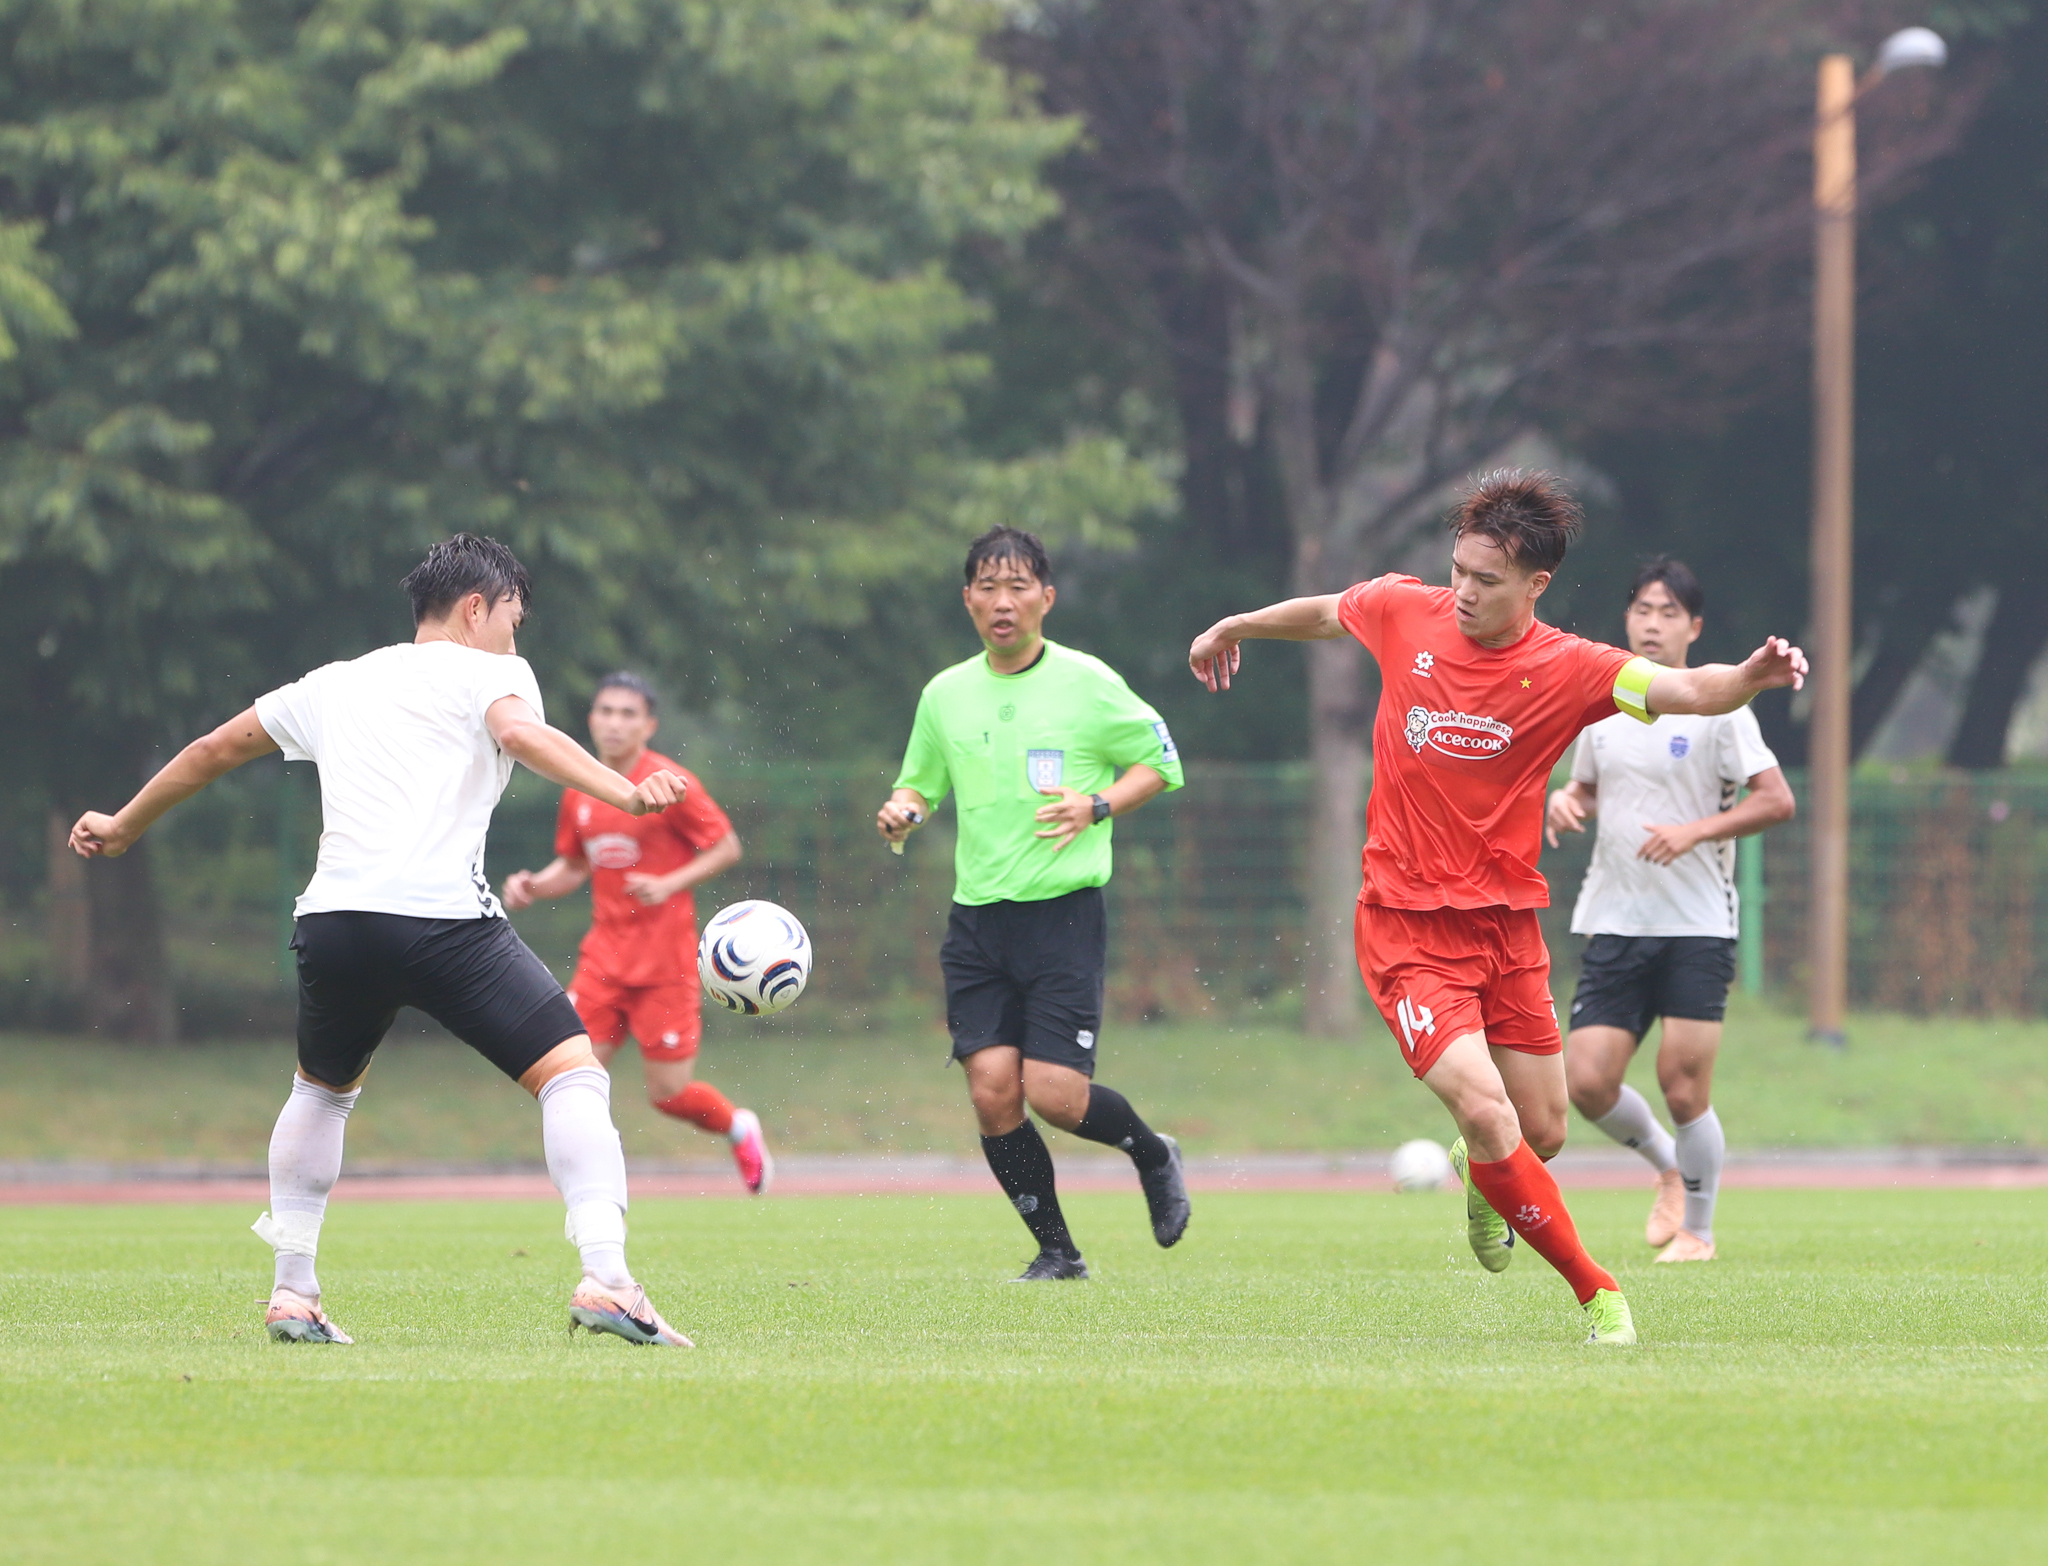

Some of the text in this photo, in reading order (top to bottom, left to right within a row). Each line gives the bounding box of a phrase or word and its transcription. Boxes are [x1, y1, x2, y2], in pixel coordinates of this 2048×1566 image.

[1431, 712, 1511, 736] Cook happiness
[1397, 995, 1436, 1053] 14
